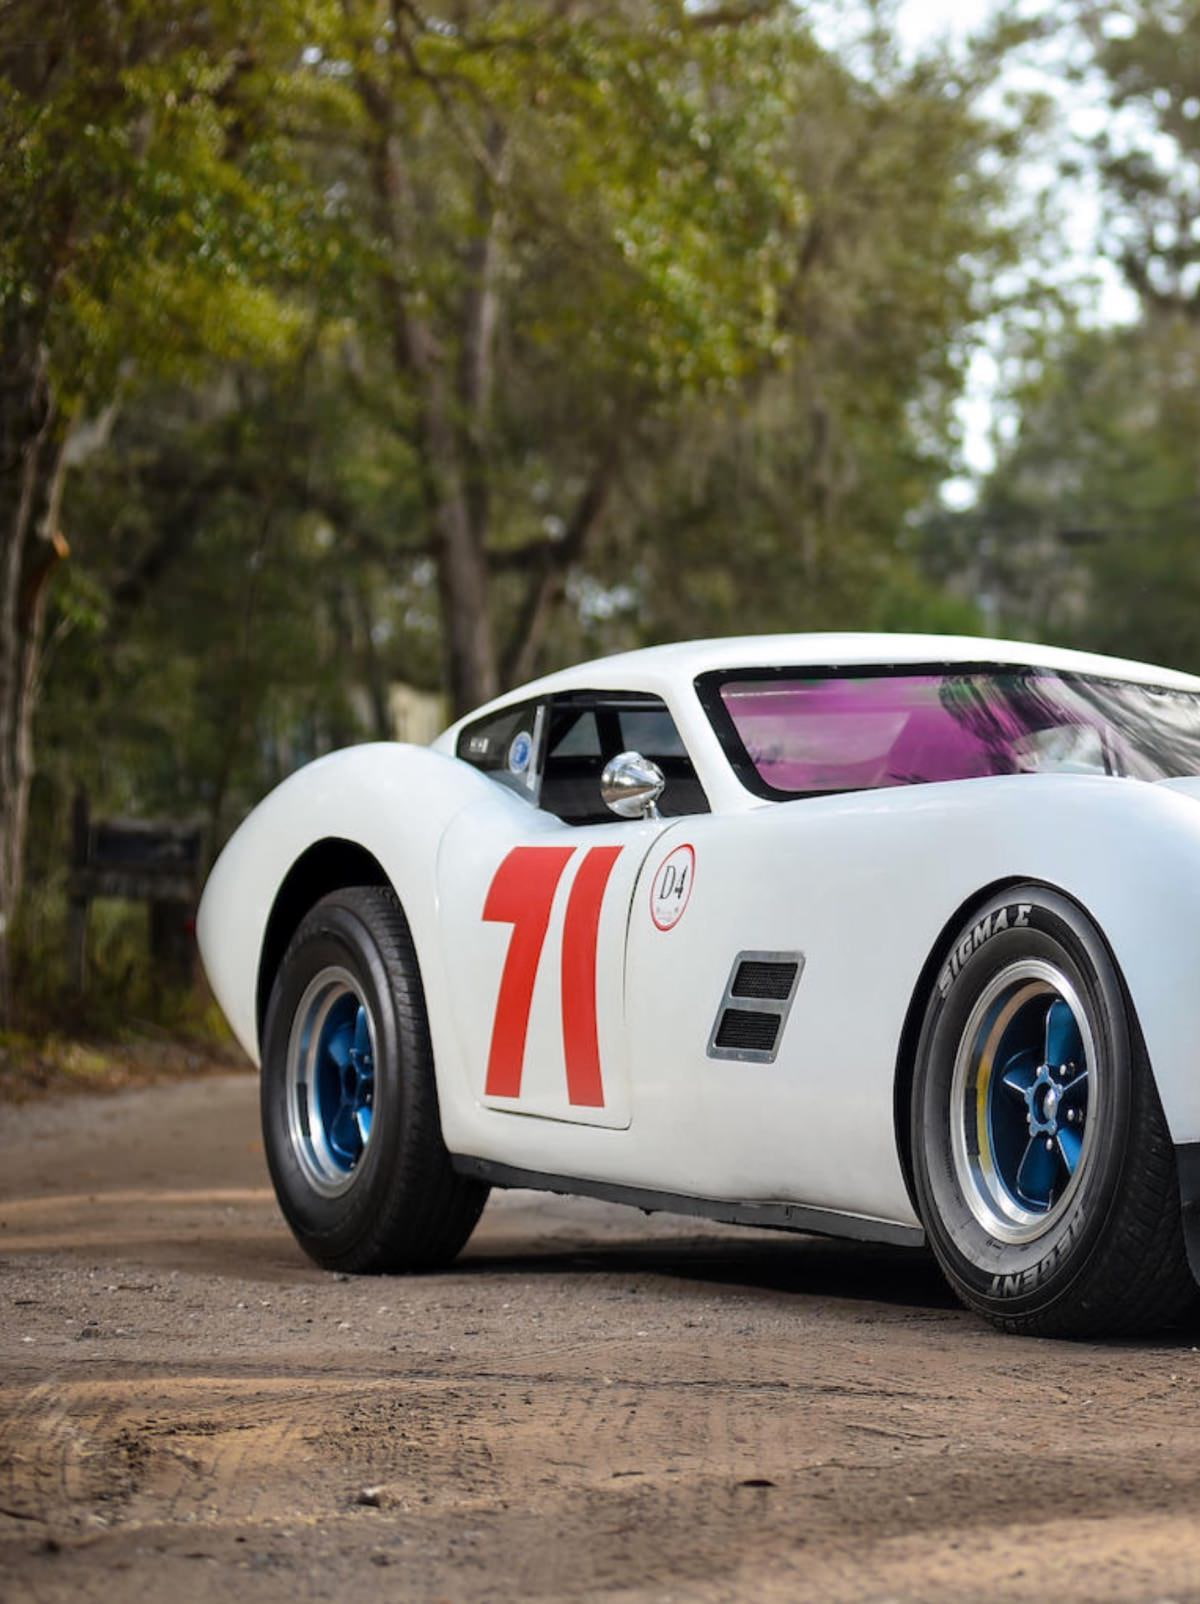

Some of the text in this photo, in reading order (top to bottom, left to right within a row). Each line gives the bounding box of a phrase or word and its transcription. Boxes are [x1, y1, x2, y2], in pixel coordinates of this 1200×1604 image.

[658, 864, 689, 900] D4
[481, 846, 624, 1108] 71
[938, 907, 1009, 999] SIGMA
